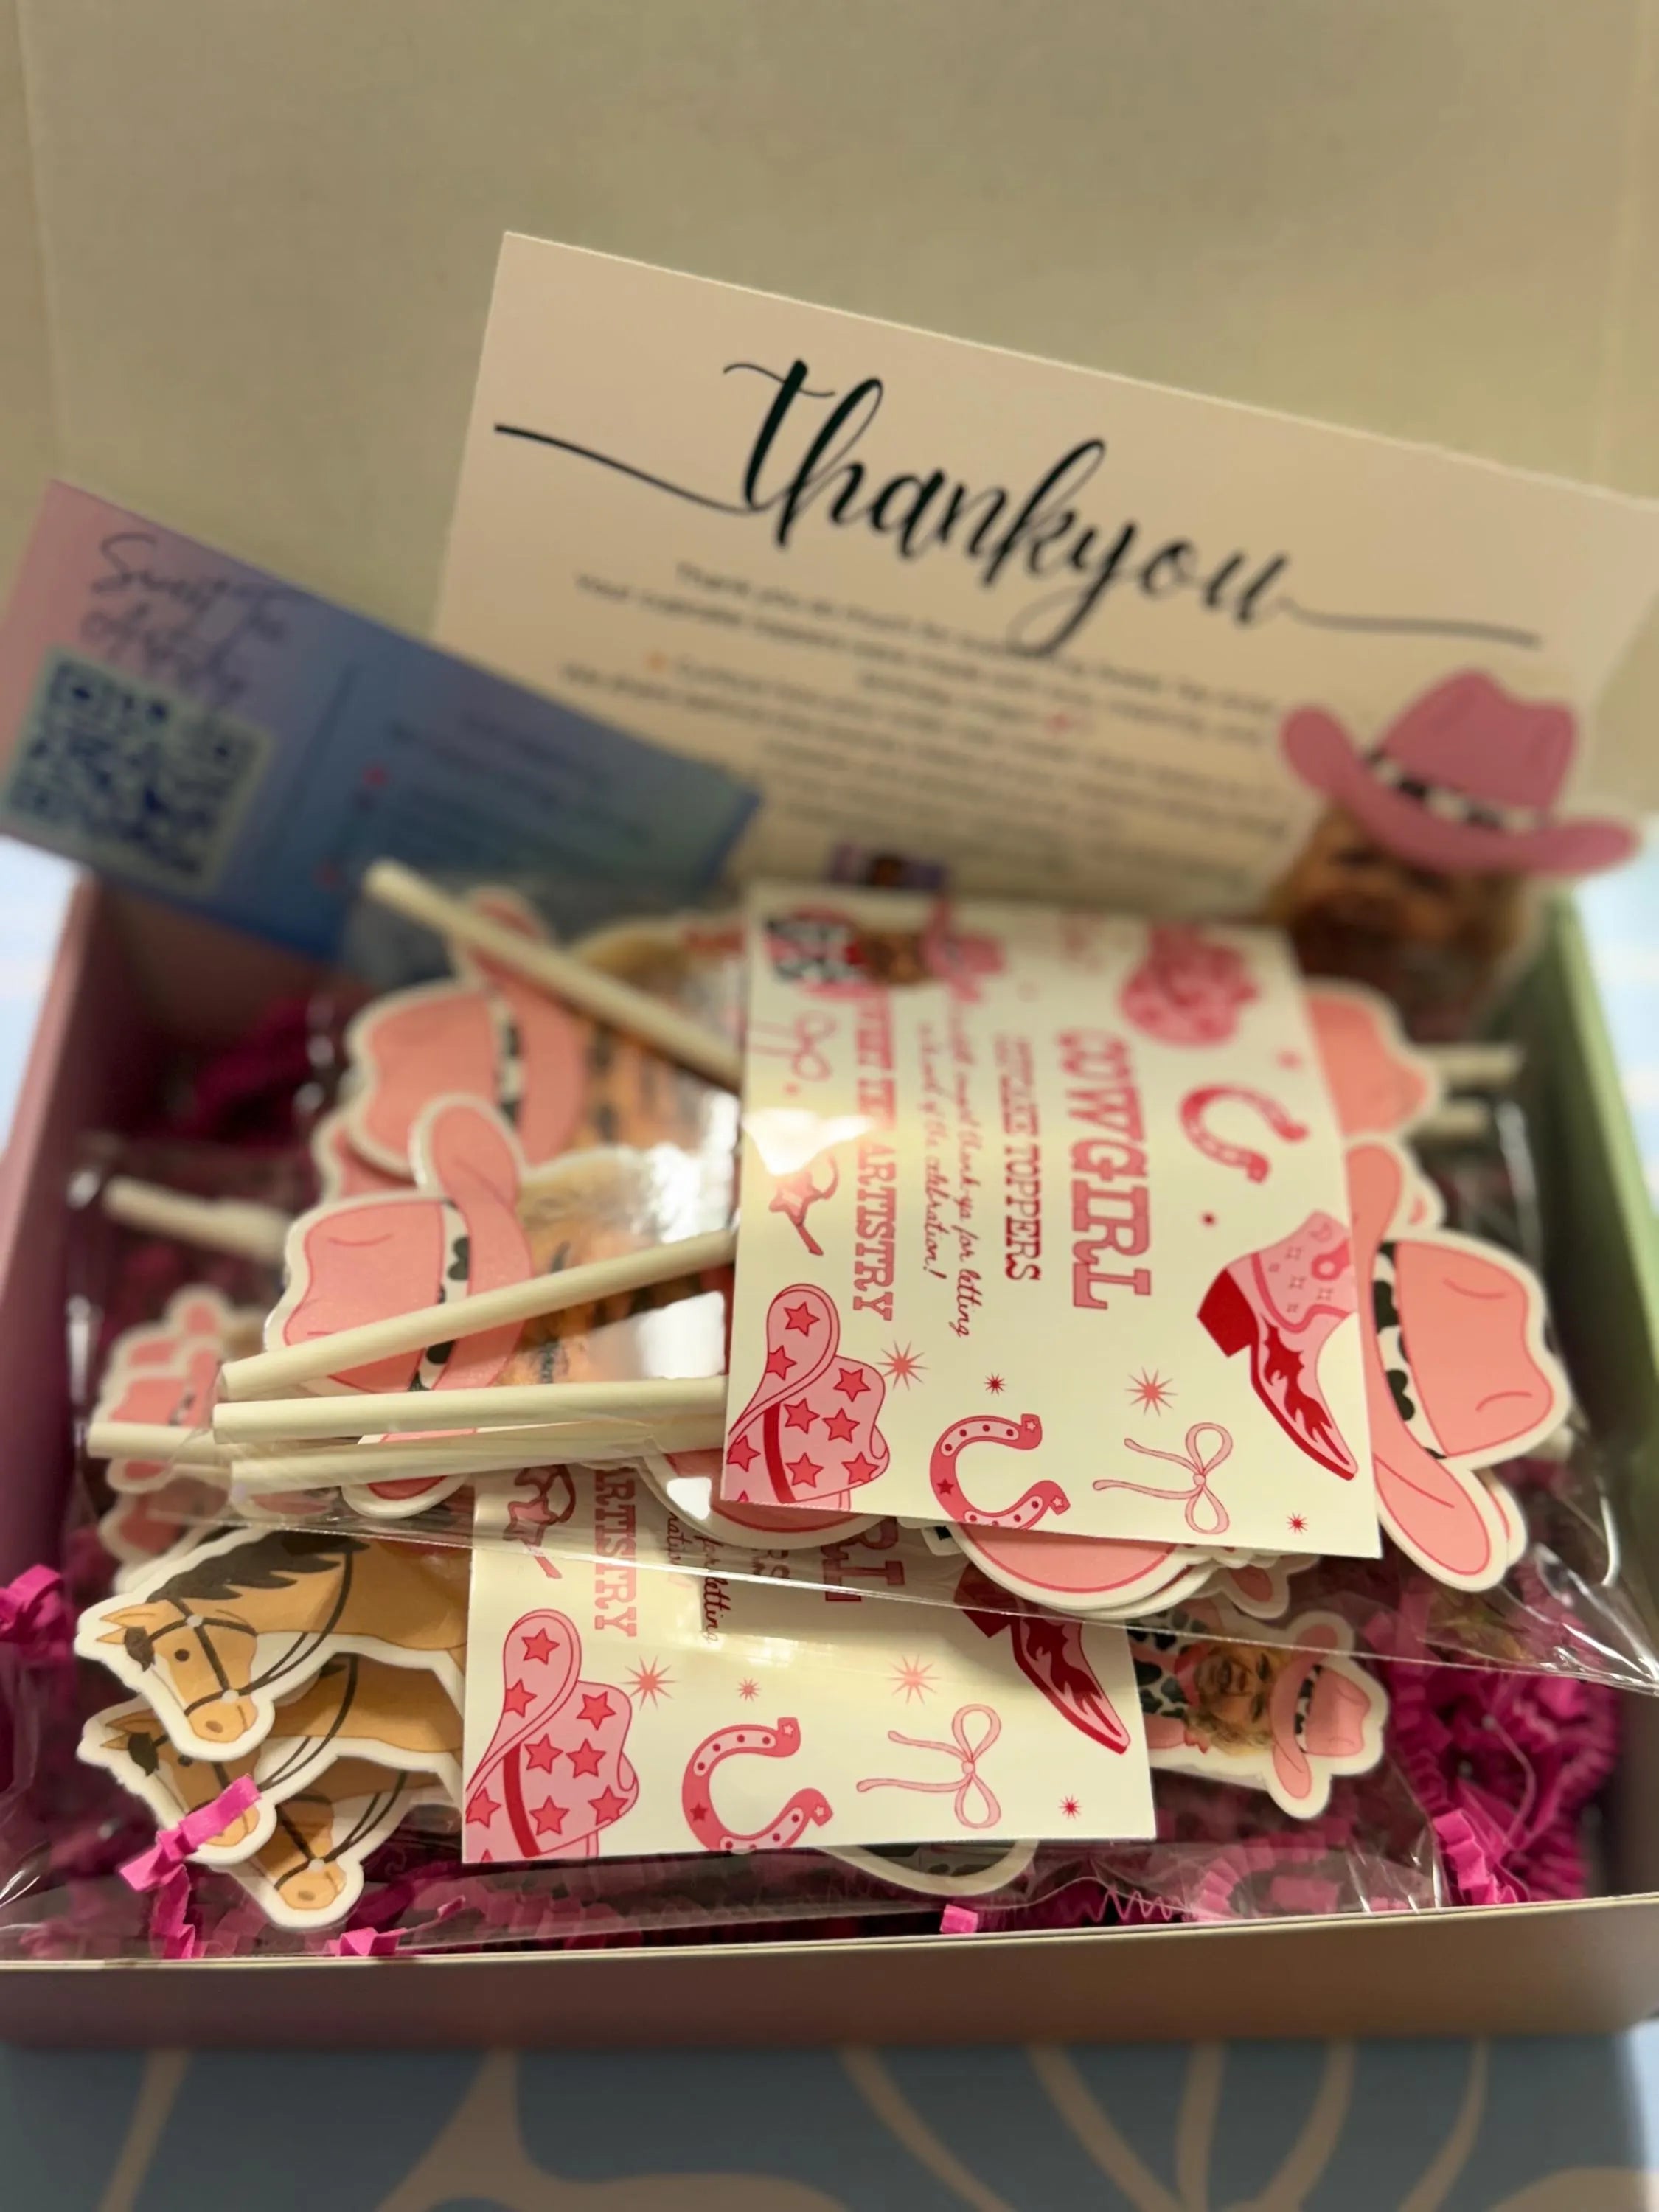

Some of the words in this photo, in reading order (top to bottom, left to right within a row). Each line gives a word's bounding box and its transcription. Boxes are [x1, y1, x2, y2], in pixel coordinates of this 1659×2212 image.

[852, 1142, 897, 1322] ARTISTRY
[922, 1155, 948, 1280] celebration!
[1005, 1144, 1043, 1281] TOPPERS
[1056, 1029, 1153, 1310] COWGIRL
[948, 1267, 983, 1340] letting
[952, 1224, 979, 1262] for
